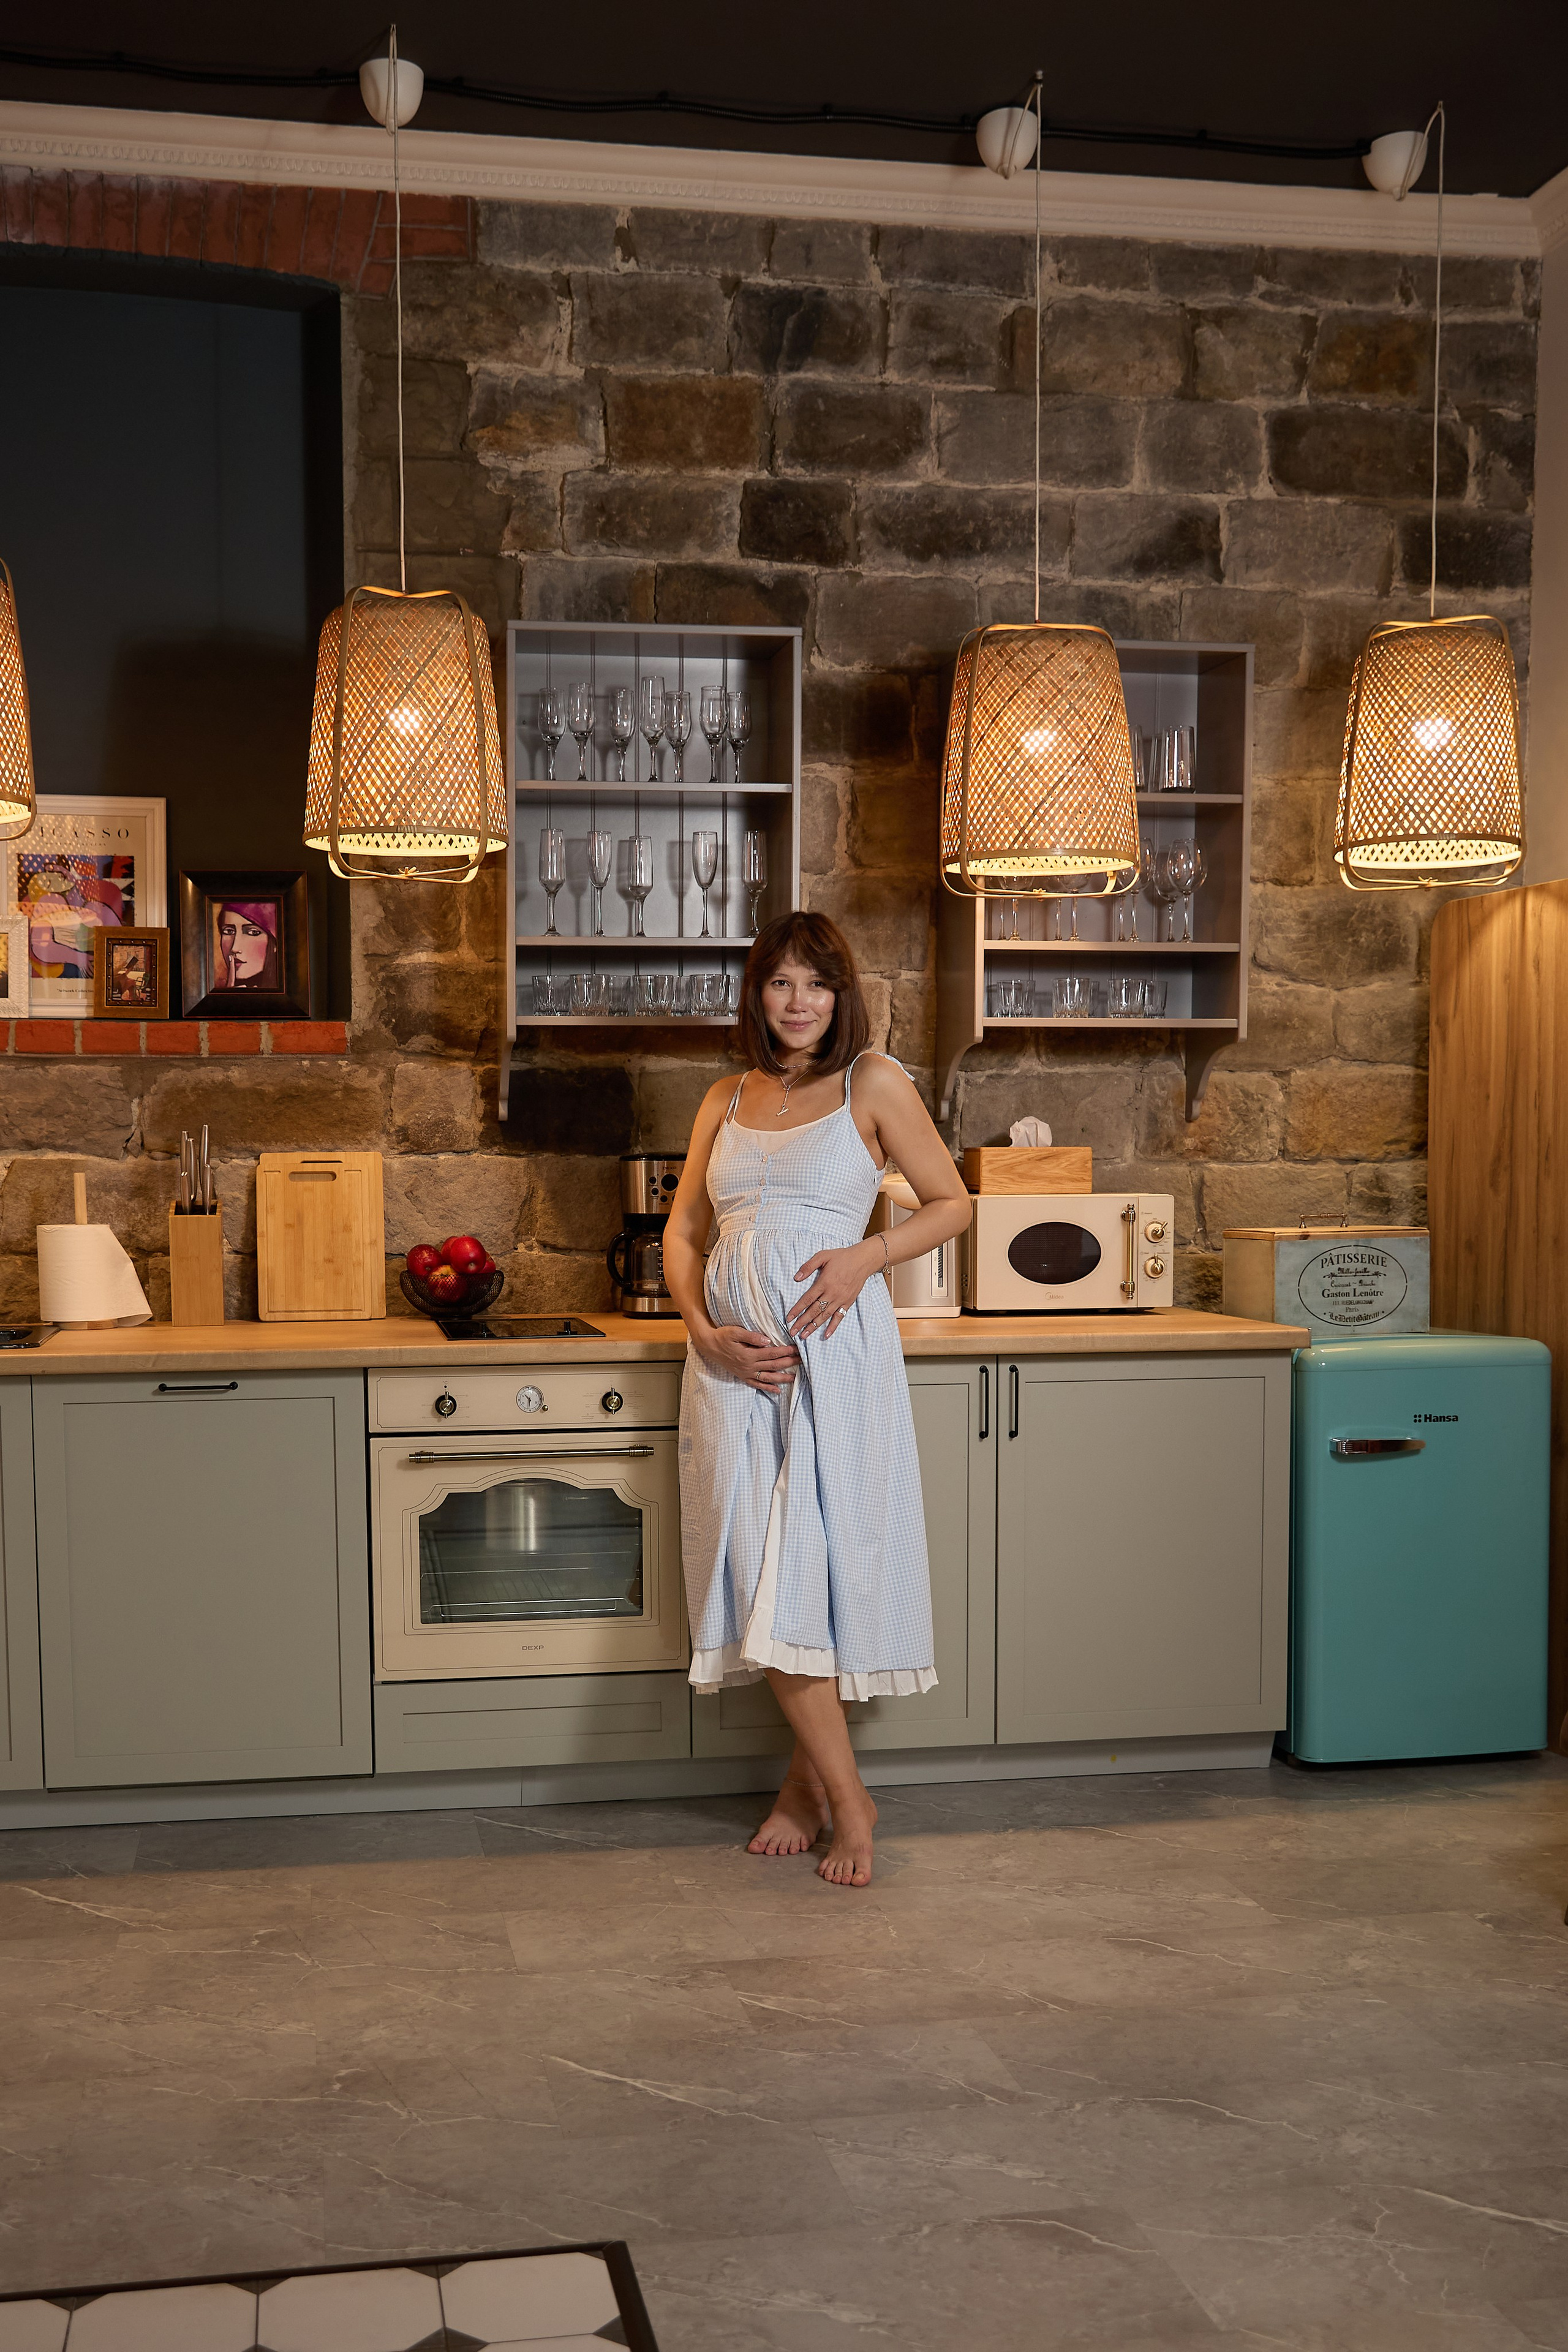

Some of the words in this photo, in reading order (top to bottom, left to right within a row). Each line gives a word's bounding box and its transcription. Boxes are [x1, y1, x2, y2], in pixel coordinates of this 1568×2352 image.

[40, 826, 129, 839] ICASSO
[1321, 1253, 1387, 1268] PÂTISSERIE
[1322, 1289, 1350, 1298] Gaston
[1353, 1288, 1384, 1297] Lenôtre
[1424, 1414, 1458, 1422] Hansa
